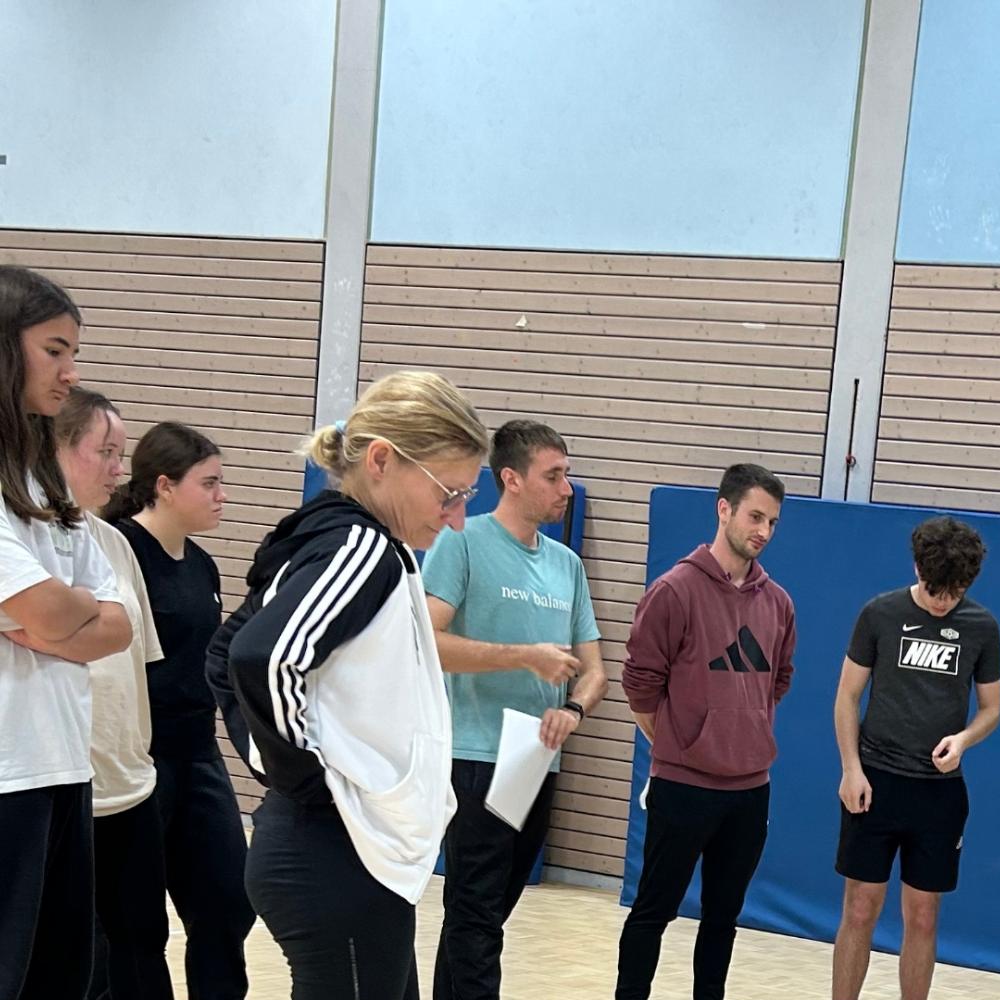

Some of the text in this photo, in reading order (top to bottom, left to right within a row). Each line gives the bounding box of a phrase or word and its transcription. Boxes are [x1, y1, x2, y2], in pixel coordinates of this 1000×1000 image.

[501, 586, 572, 612] new balanc
[902, 641, 956, 670] NIKE
